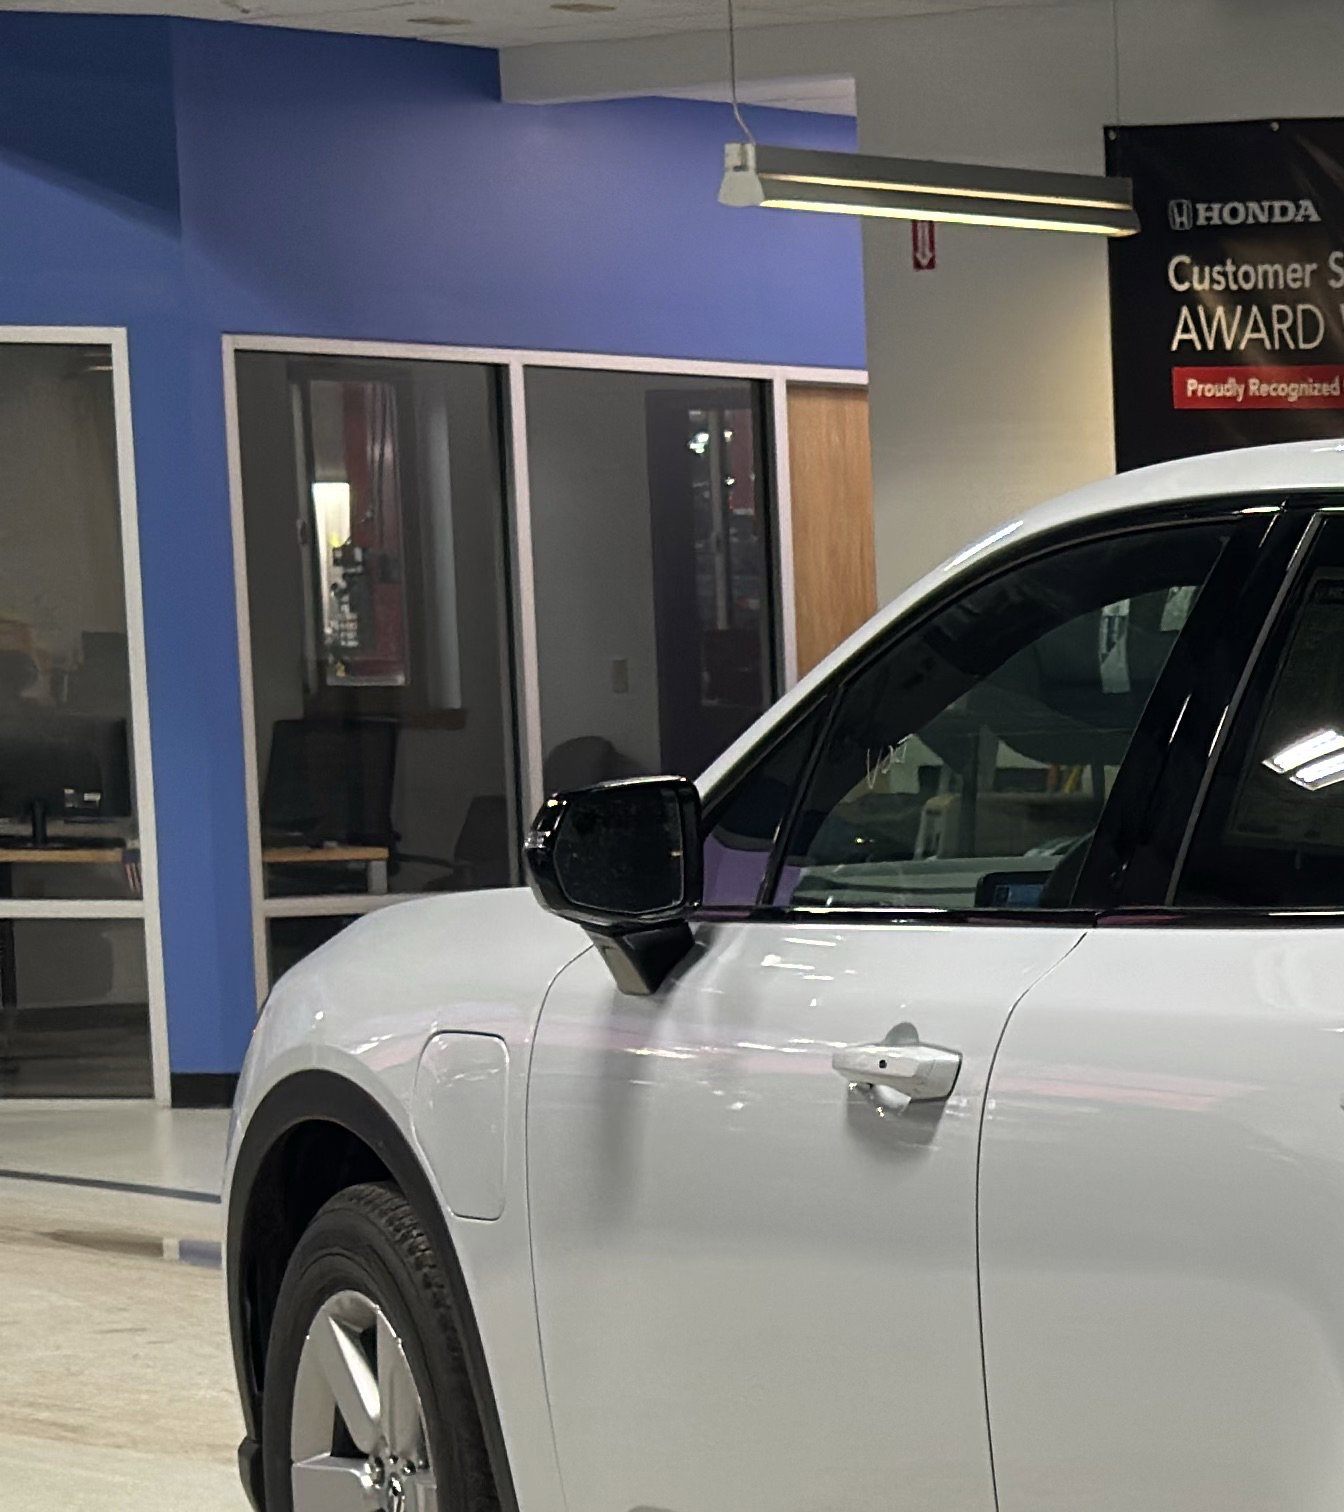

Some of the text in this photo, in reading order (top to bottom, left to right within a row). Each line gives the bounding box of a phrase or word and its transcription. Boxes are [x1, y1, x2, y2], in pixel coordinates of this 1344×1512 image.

[1195, 199, 1322, 226] HONDA
[1168, 254, 1318, 292] Customer
[1171, 304, 1326, 351] AWARD
[1186, 376, 1245, 401] Proudly
[1248, 376, 1340, 401] Recognized
